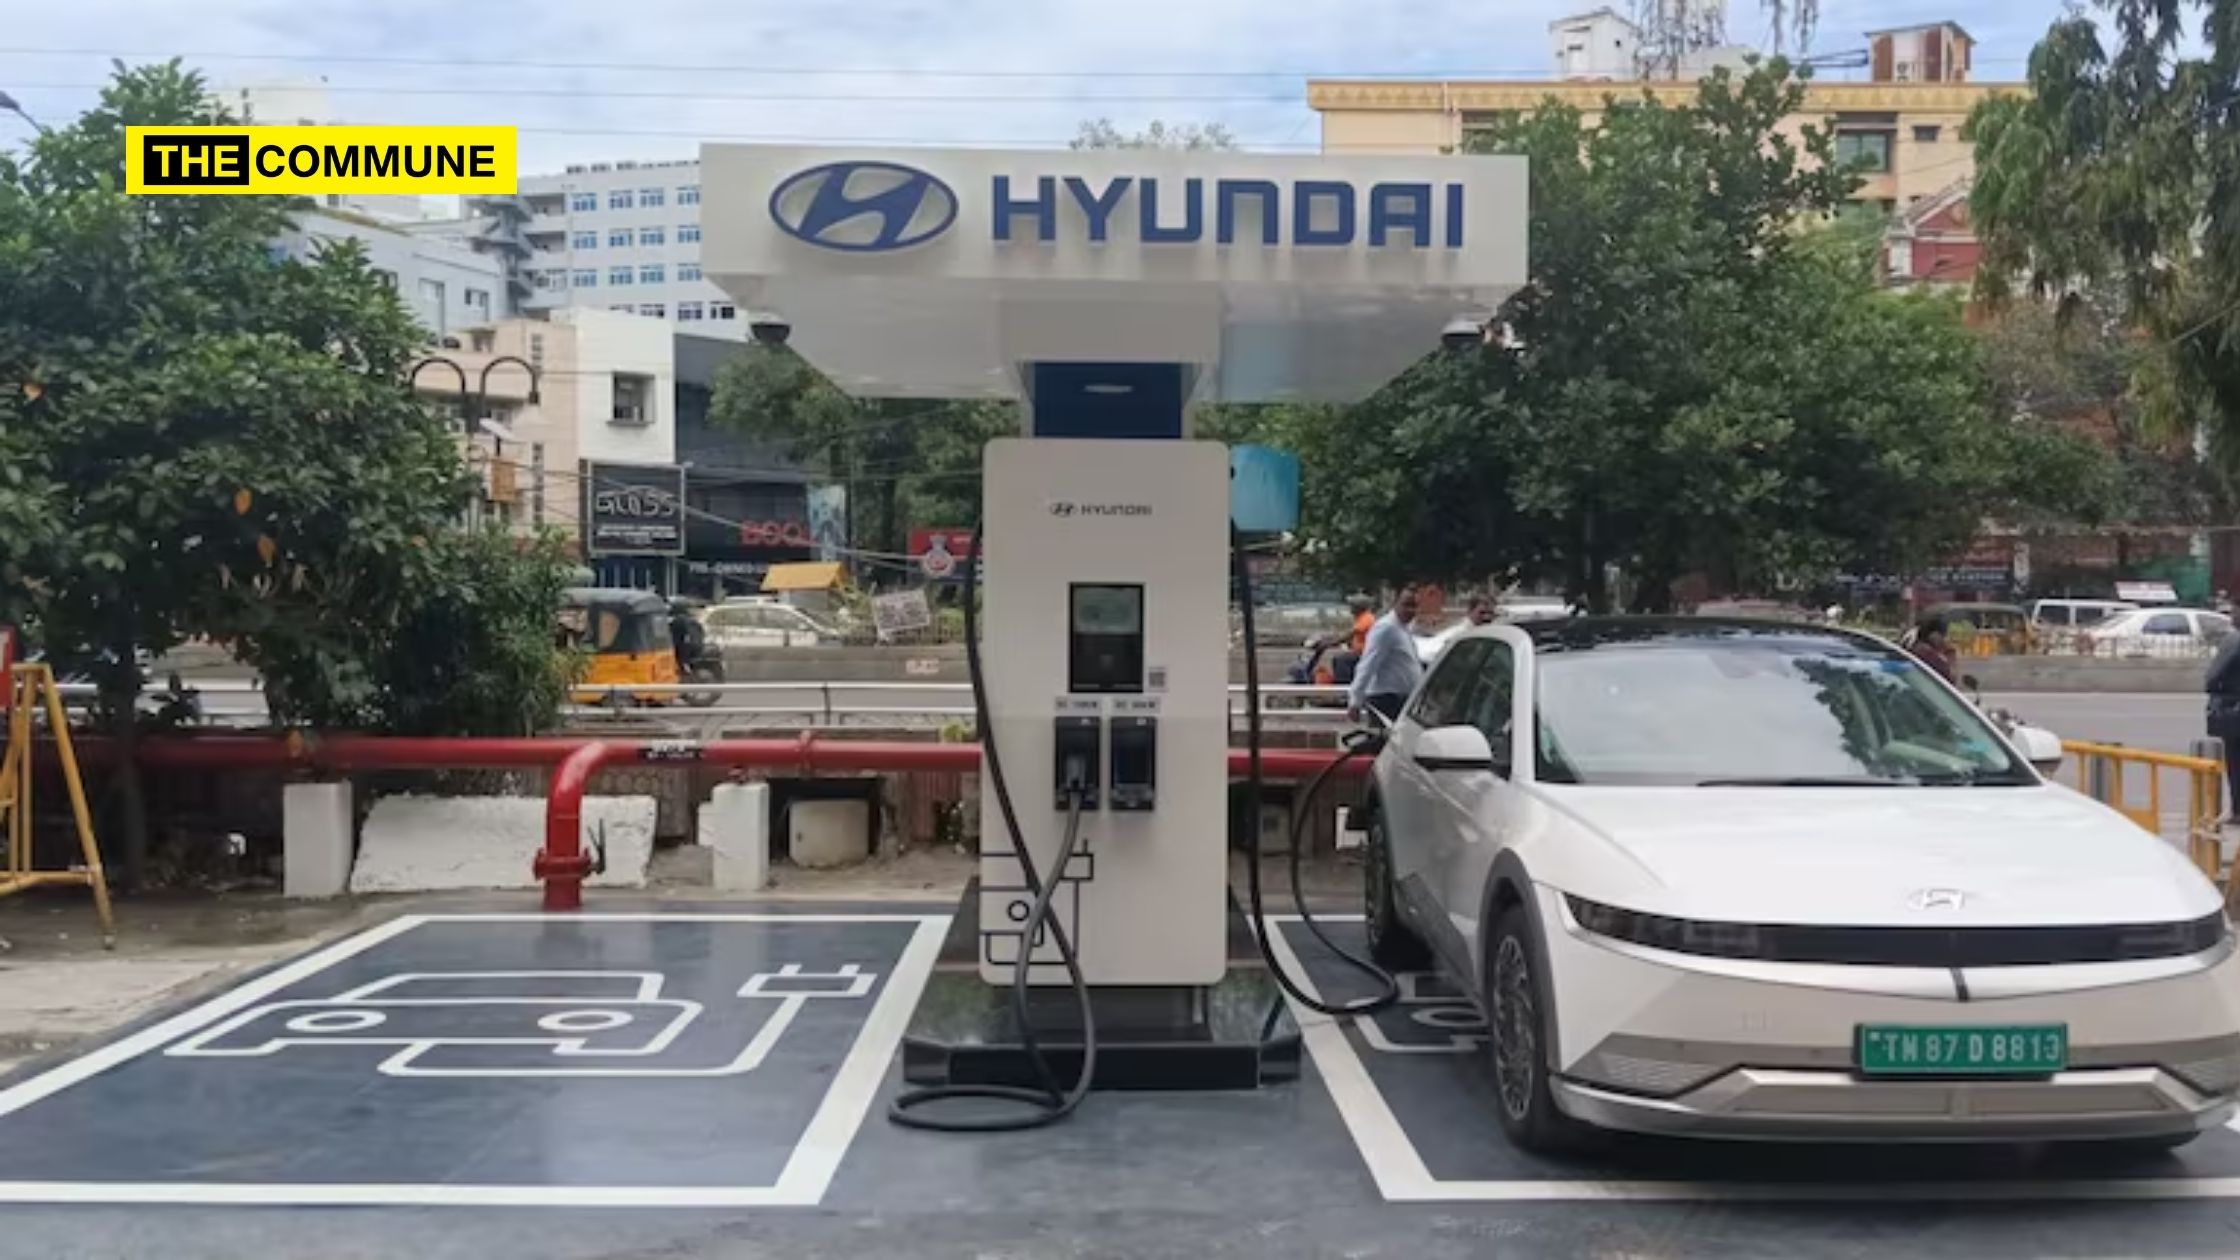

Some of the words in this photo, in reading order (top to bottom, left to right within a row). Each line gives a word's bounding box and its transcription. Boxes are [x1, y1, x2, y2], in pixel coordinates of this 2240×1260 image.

[992, 174, 1464, 248] HYUNDAI
[1081, 504, 1153, 516] HYUNDAI
[1925, 1034, 1959, 1063] 87
[1968, 1034, 1984, 1063] D
[1991, 1033, 2061, 1062] 8813
